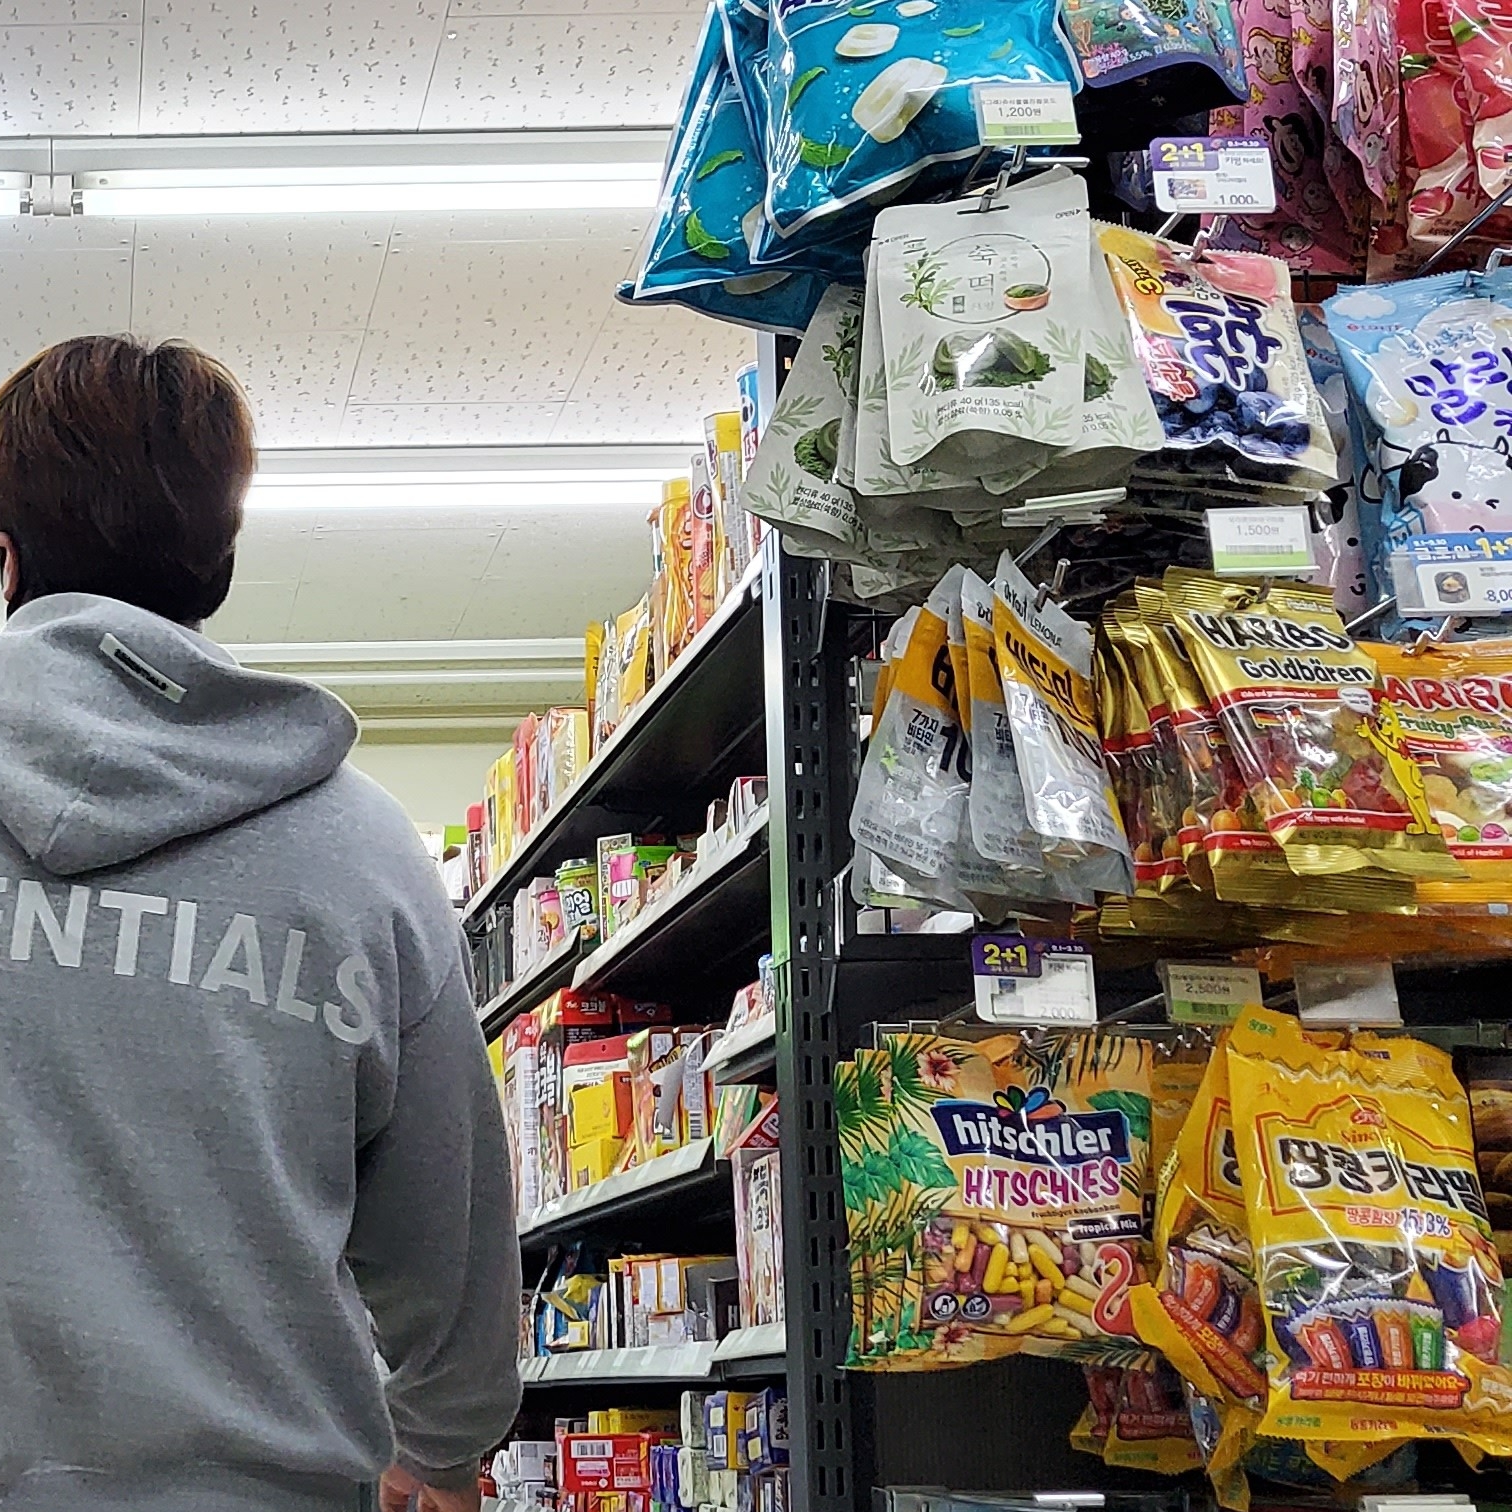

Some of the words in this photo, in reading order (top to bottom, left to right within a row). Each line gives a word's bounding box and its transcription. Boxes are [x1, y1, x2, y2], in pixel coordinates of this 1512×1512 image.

[997, 106, 1043, 120] 1,200원
[1160, 142, 1206, 163] 2+1
[1055, 209, 1076, 220] OPEN
[1191, 610, 1351, 651] HARIBO
[1240, 657, 1373, 684] Goldbären
[1384, 675, 1512, 713] ARIB
[983, 944, 1028, 966] 2+1
[954, 1114, 1114, 1158] hitschler
[964, 1158, 1122, 1210] HITSCHIES
[1278, 1138, 1492, 1222] 땅콩카라멜
[1120, 1219, 1139, 1232] Mix
